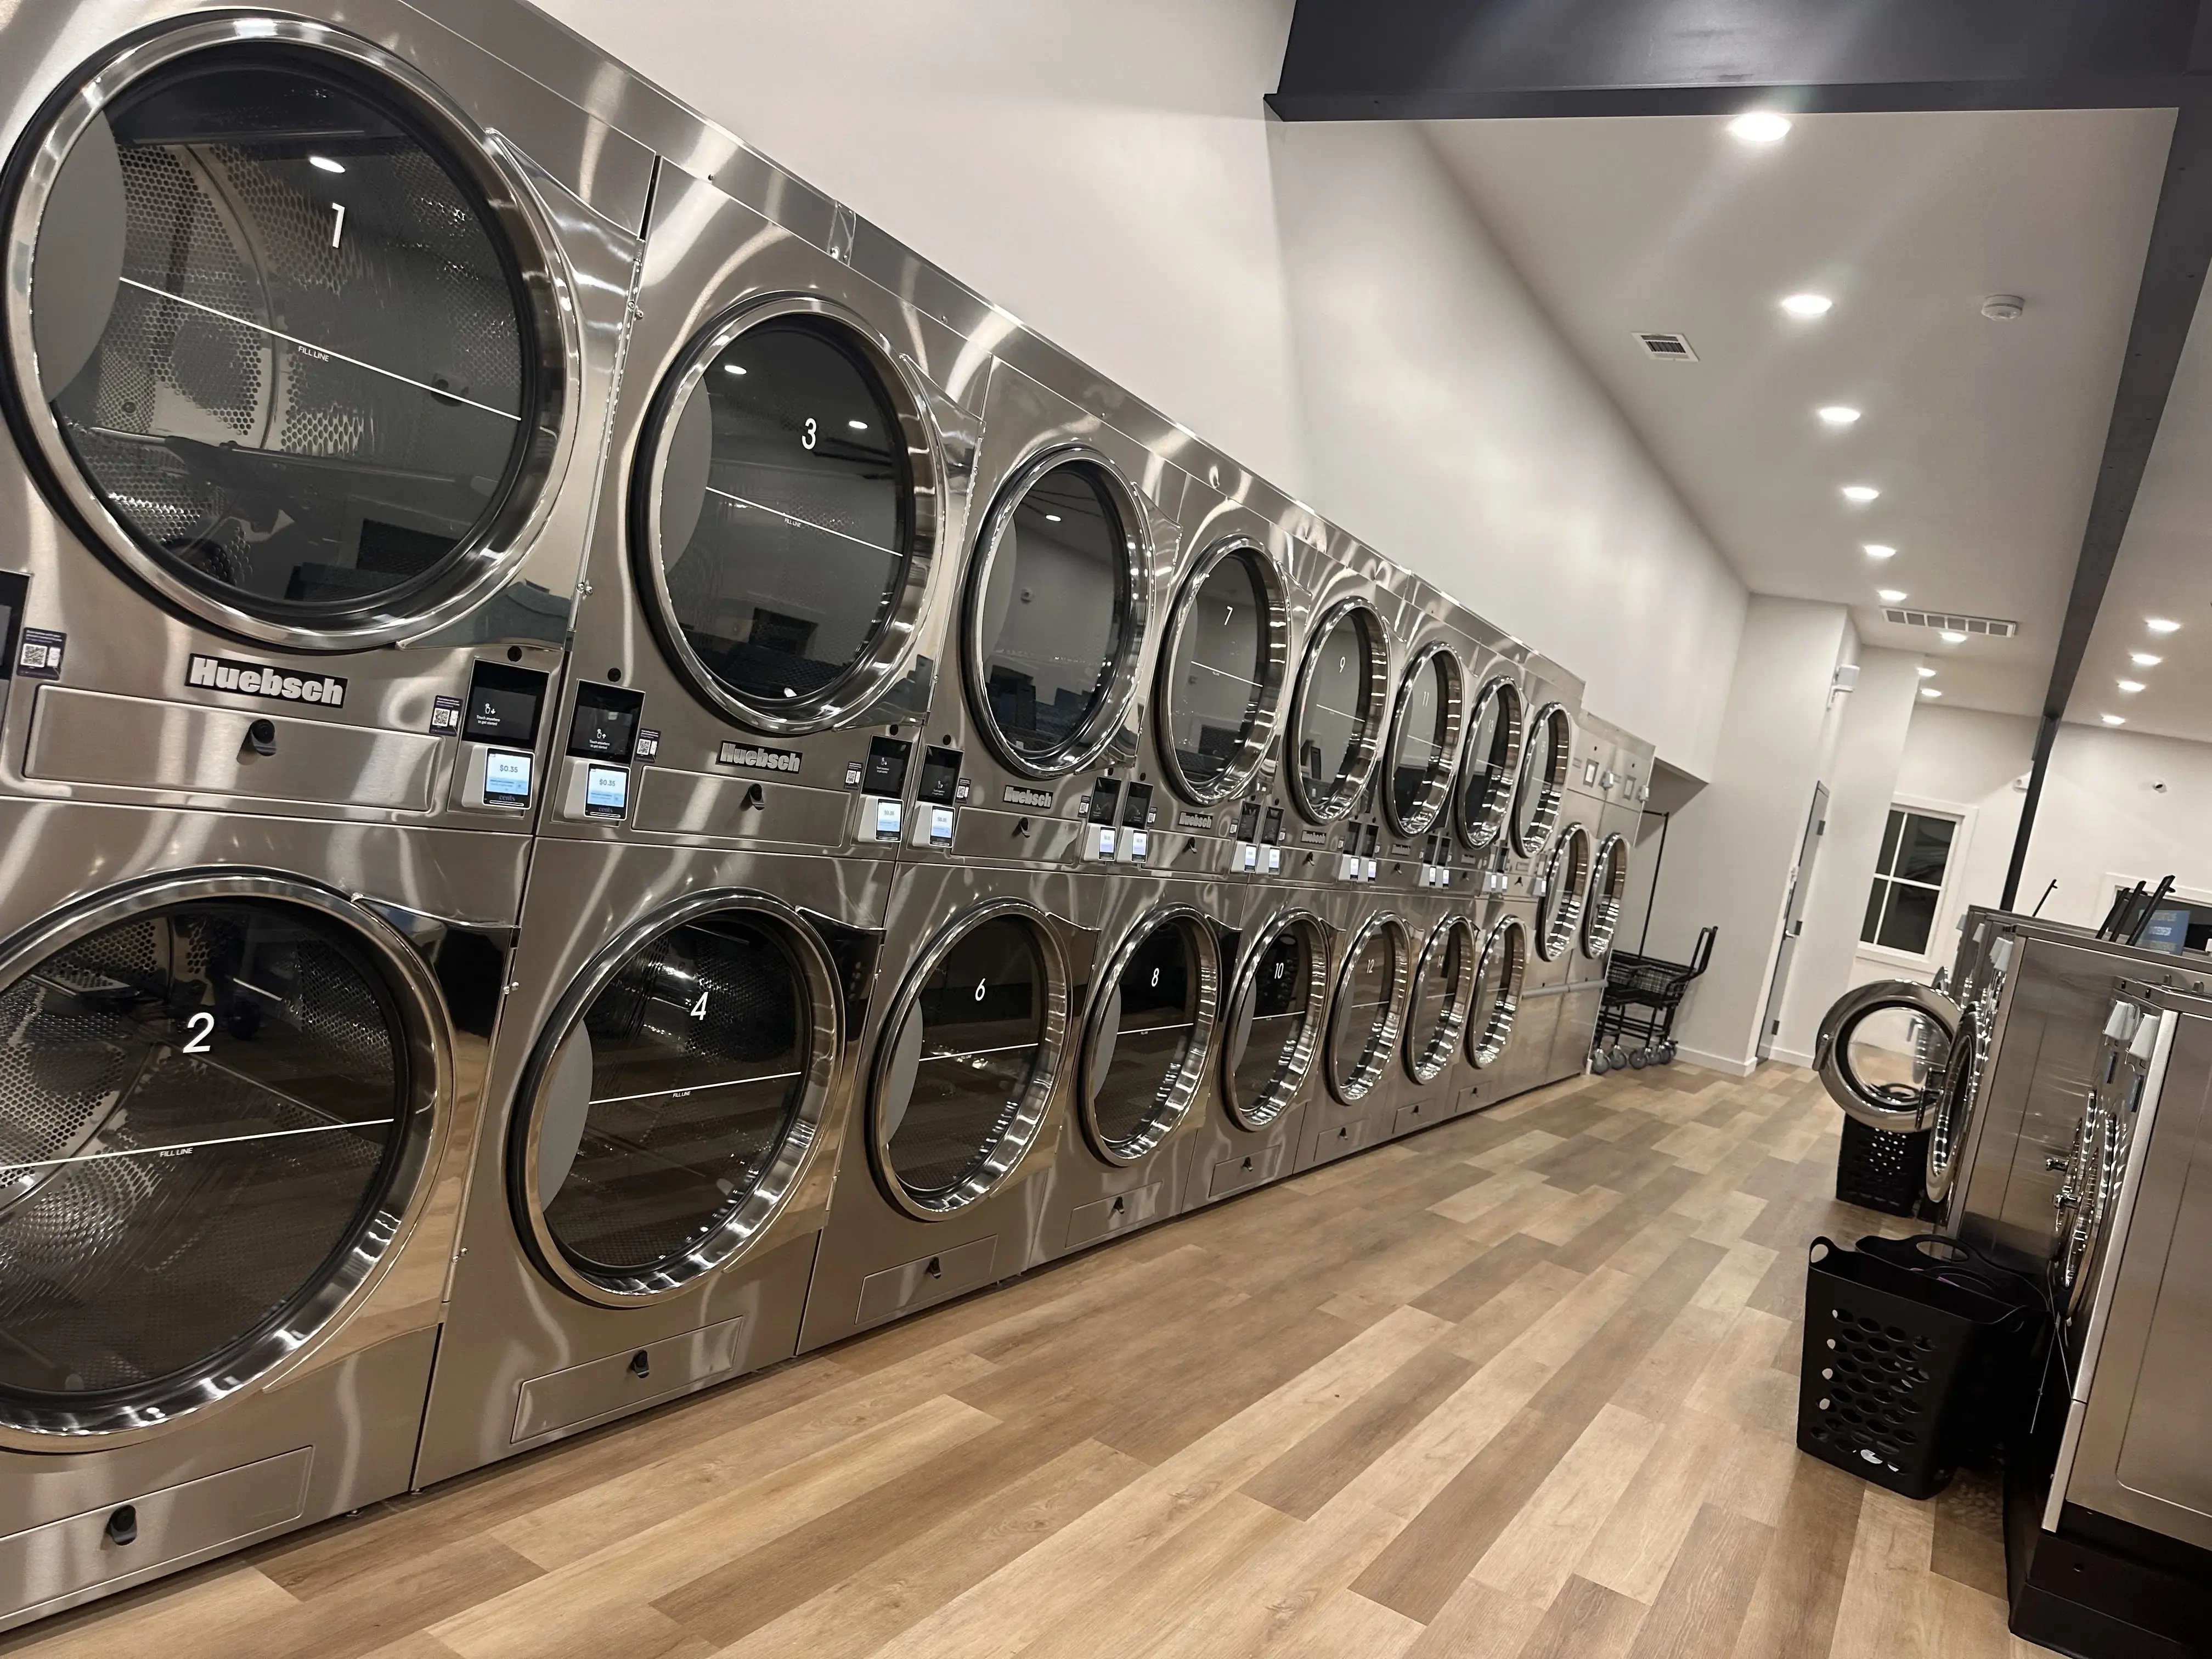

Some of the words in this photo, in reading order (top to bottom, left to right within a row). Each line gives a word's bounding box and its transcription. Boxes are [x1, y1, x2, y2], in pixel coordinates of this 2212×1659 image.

[332, 202, 345, 248] 1
[298, 346, 313, 356] FILL
[313, 351, 329, 362] LINE
[802, 417, 817, 450] 3
[1224, 606, 1233, 625] 7
[1339, 656, 1346, 673] 9
[189, 657, 343, 706] Huebsch
[1422, 691, 1430, 707] 11
[720, 742, 800, 772] Huebsch
[500, 764, 518, 773] $0.35
[599, 778, 616, 787] $0.35
[1274, 962, 1284, 979] 10
[1367, 959, 1375, 974] 12
[1152, 967, 1160, 987] 8
[975, 978, 986, 1001] 6
[690, 991, 709, 1020] 4
[183, 1012, 215, 1053] 2
[176, 1147, 194, 1155] LINE
